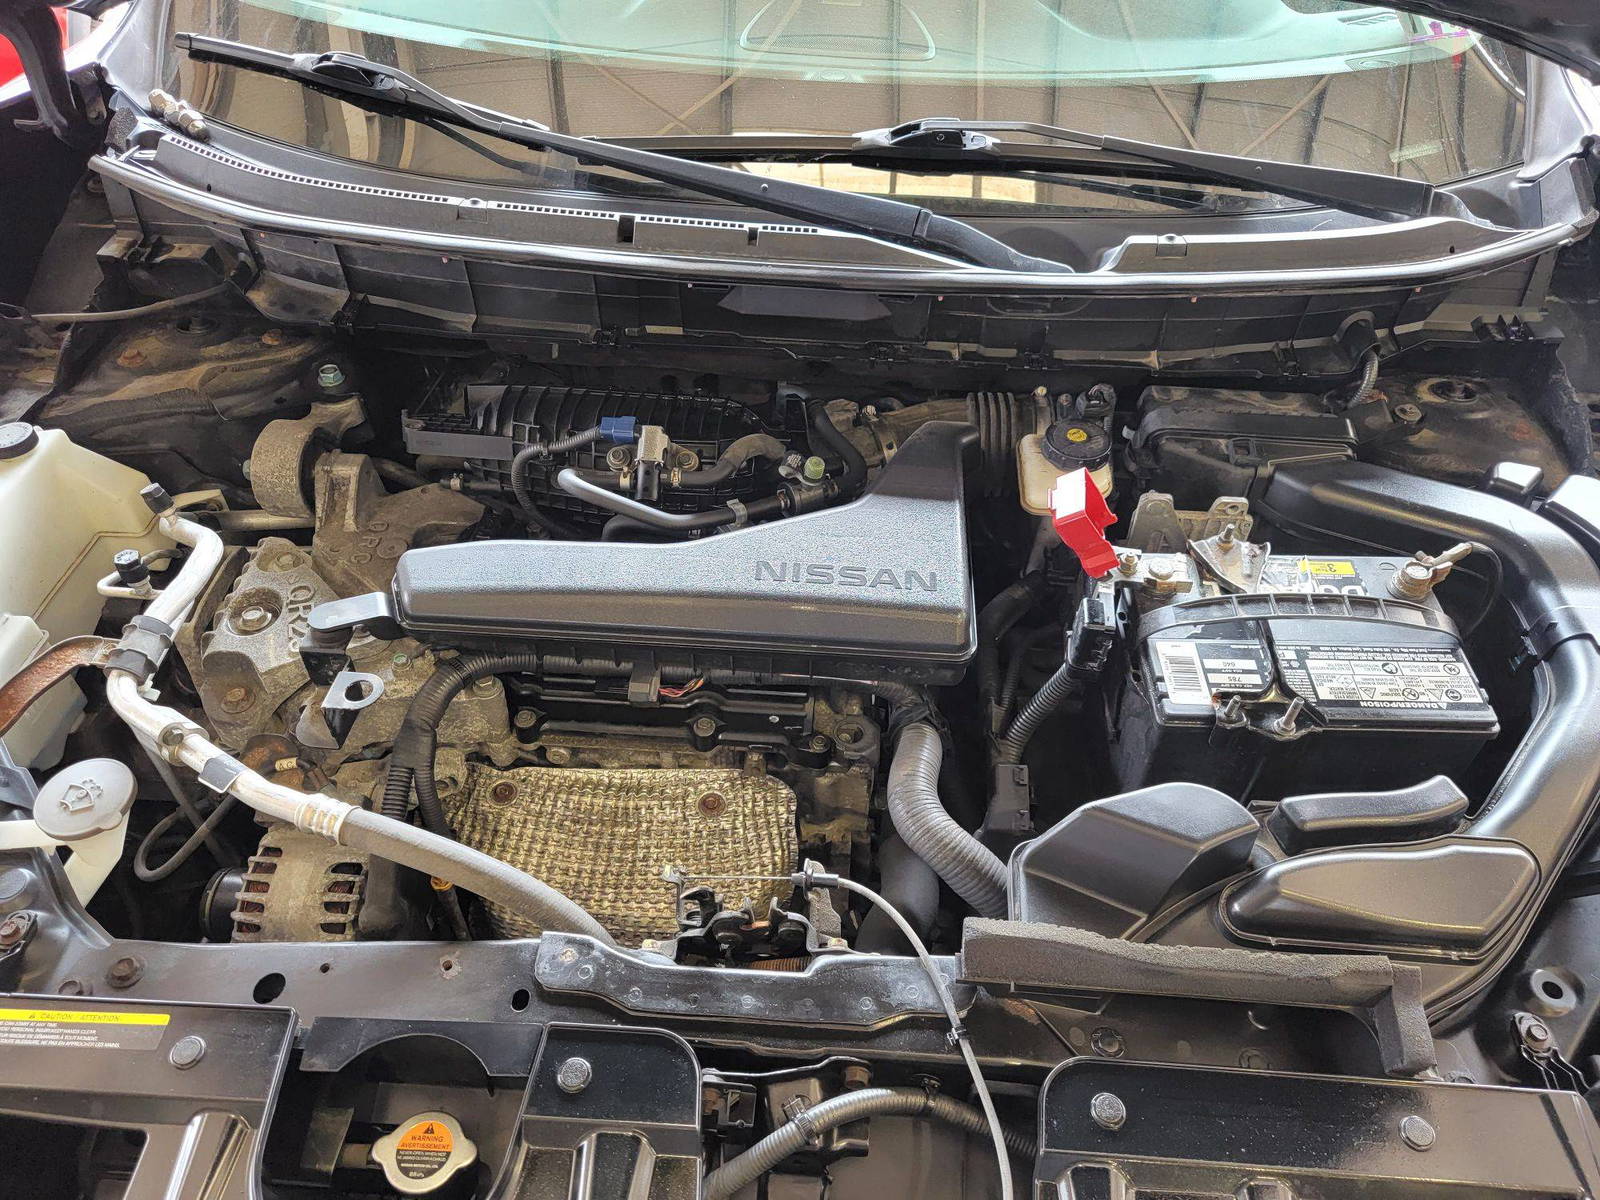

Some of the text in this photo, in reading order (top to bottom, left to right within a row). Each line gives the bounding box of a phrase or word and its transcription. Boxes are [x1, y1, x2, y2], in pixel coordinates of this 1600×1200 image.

[1326, 563, 1337, 573] 3
[754, 560, 938, 592] NISSAN
[39, 1013, 72, 1021] CAUTION
